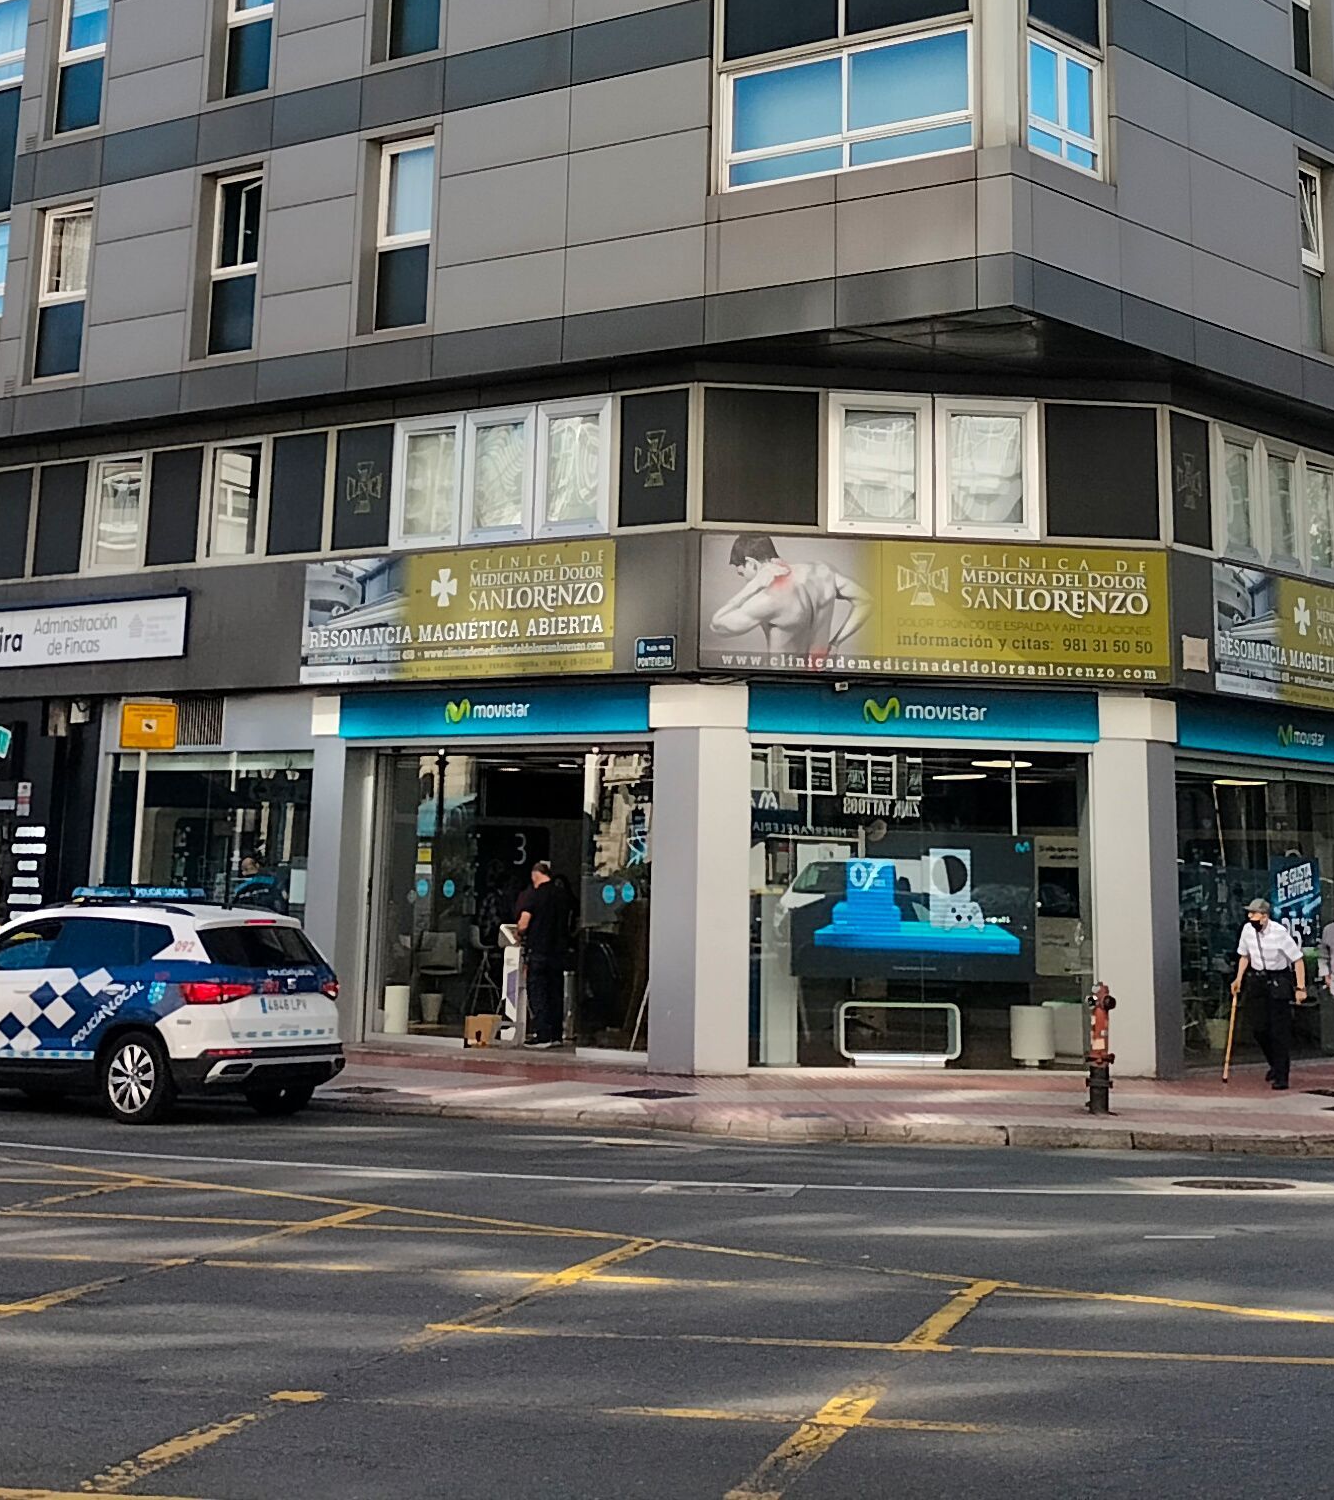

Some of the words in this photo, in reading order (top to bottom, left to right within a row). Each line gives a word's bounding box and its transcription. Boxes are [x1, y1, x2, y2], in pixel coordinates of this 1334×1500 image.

[470, 552, 562, 571] CLÍNICA
[581, 550, 605, 563] DE
[960, 553, 1089, 571] CLÍNICA
[1117, 560, 1147, 573] DE
[470, 567, 531, 587] MEDICINA
[533, 567, 556, 583] DEL
[559, 565, 605, 581] DOLOR
[960, 570, 1047, 586] MEDICINA
[1052, 573, 1083, 587] DEL
[1088, 573, 1147, 590] DOLOR
[469, 581, 605, 613] SANLORENZO
[962, 587, 1149, 619] SANLORENZO
[33, 612, 118, 635] Administración
[309, 626, 413, 649] RESONANCIA
[418, 617, 520, 643] MAGNÉTICA
[525, 614, 605, 637] ABIERTA
[987, 620, 1002, 631] DE
[1003, 620, 1052, 632] ESPALDA
[1060, 623, 1152, 636] ARTICULACIONES
[47, 638, 63, 656] de
[64, 636, 100, 655] Fincas
[897, 632, 993, 649] información
[998, 638, 1007, 652] y
[1012, 636, 1053, 651] citas:
[1062, 637, 1088, 652] 981
[1093, 638, 1108, 652] 31
[1113, 640, 1130, 653] 50
[1135, 641, 1153, 654] 50
[1219, 636, 1288, 665] RESONANCIA
[473, 701, 530, 719] movistar
[905, 704, 987, 721] movistar
[1293, 730, 1325, 747] movistar
[1288, 862, 1312, 885] GUSTA
[175, 940, 195, 952] 092
[107, 981, 144, 1009] LOCAL
